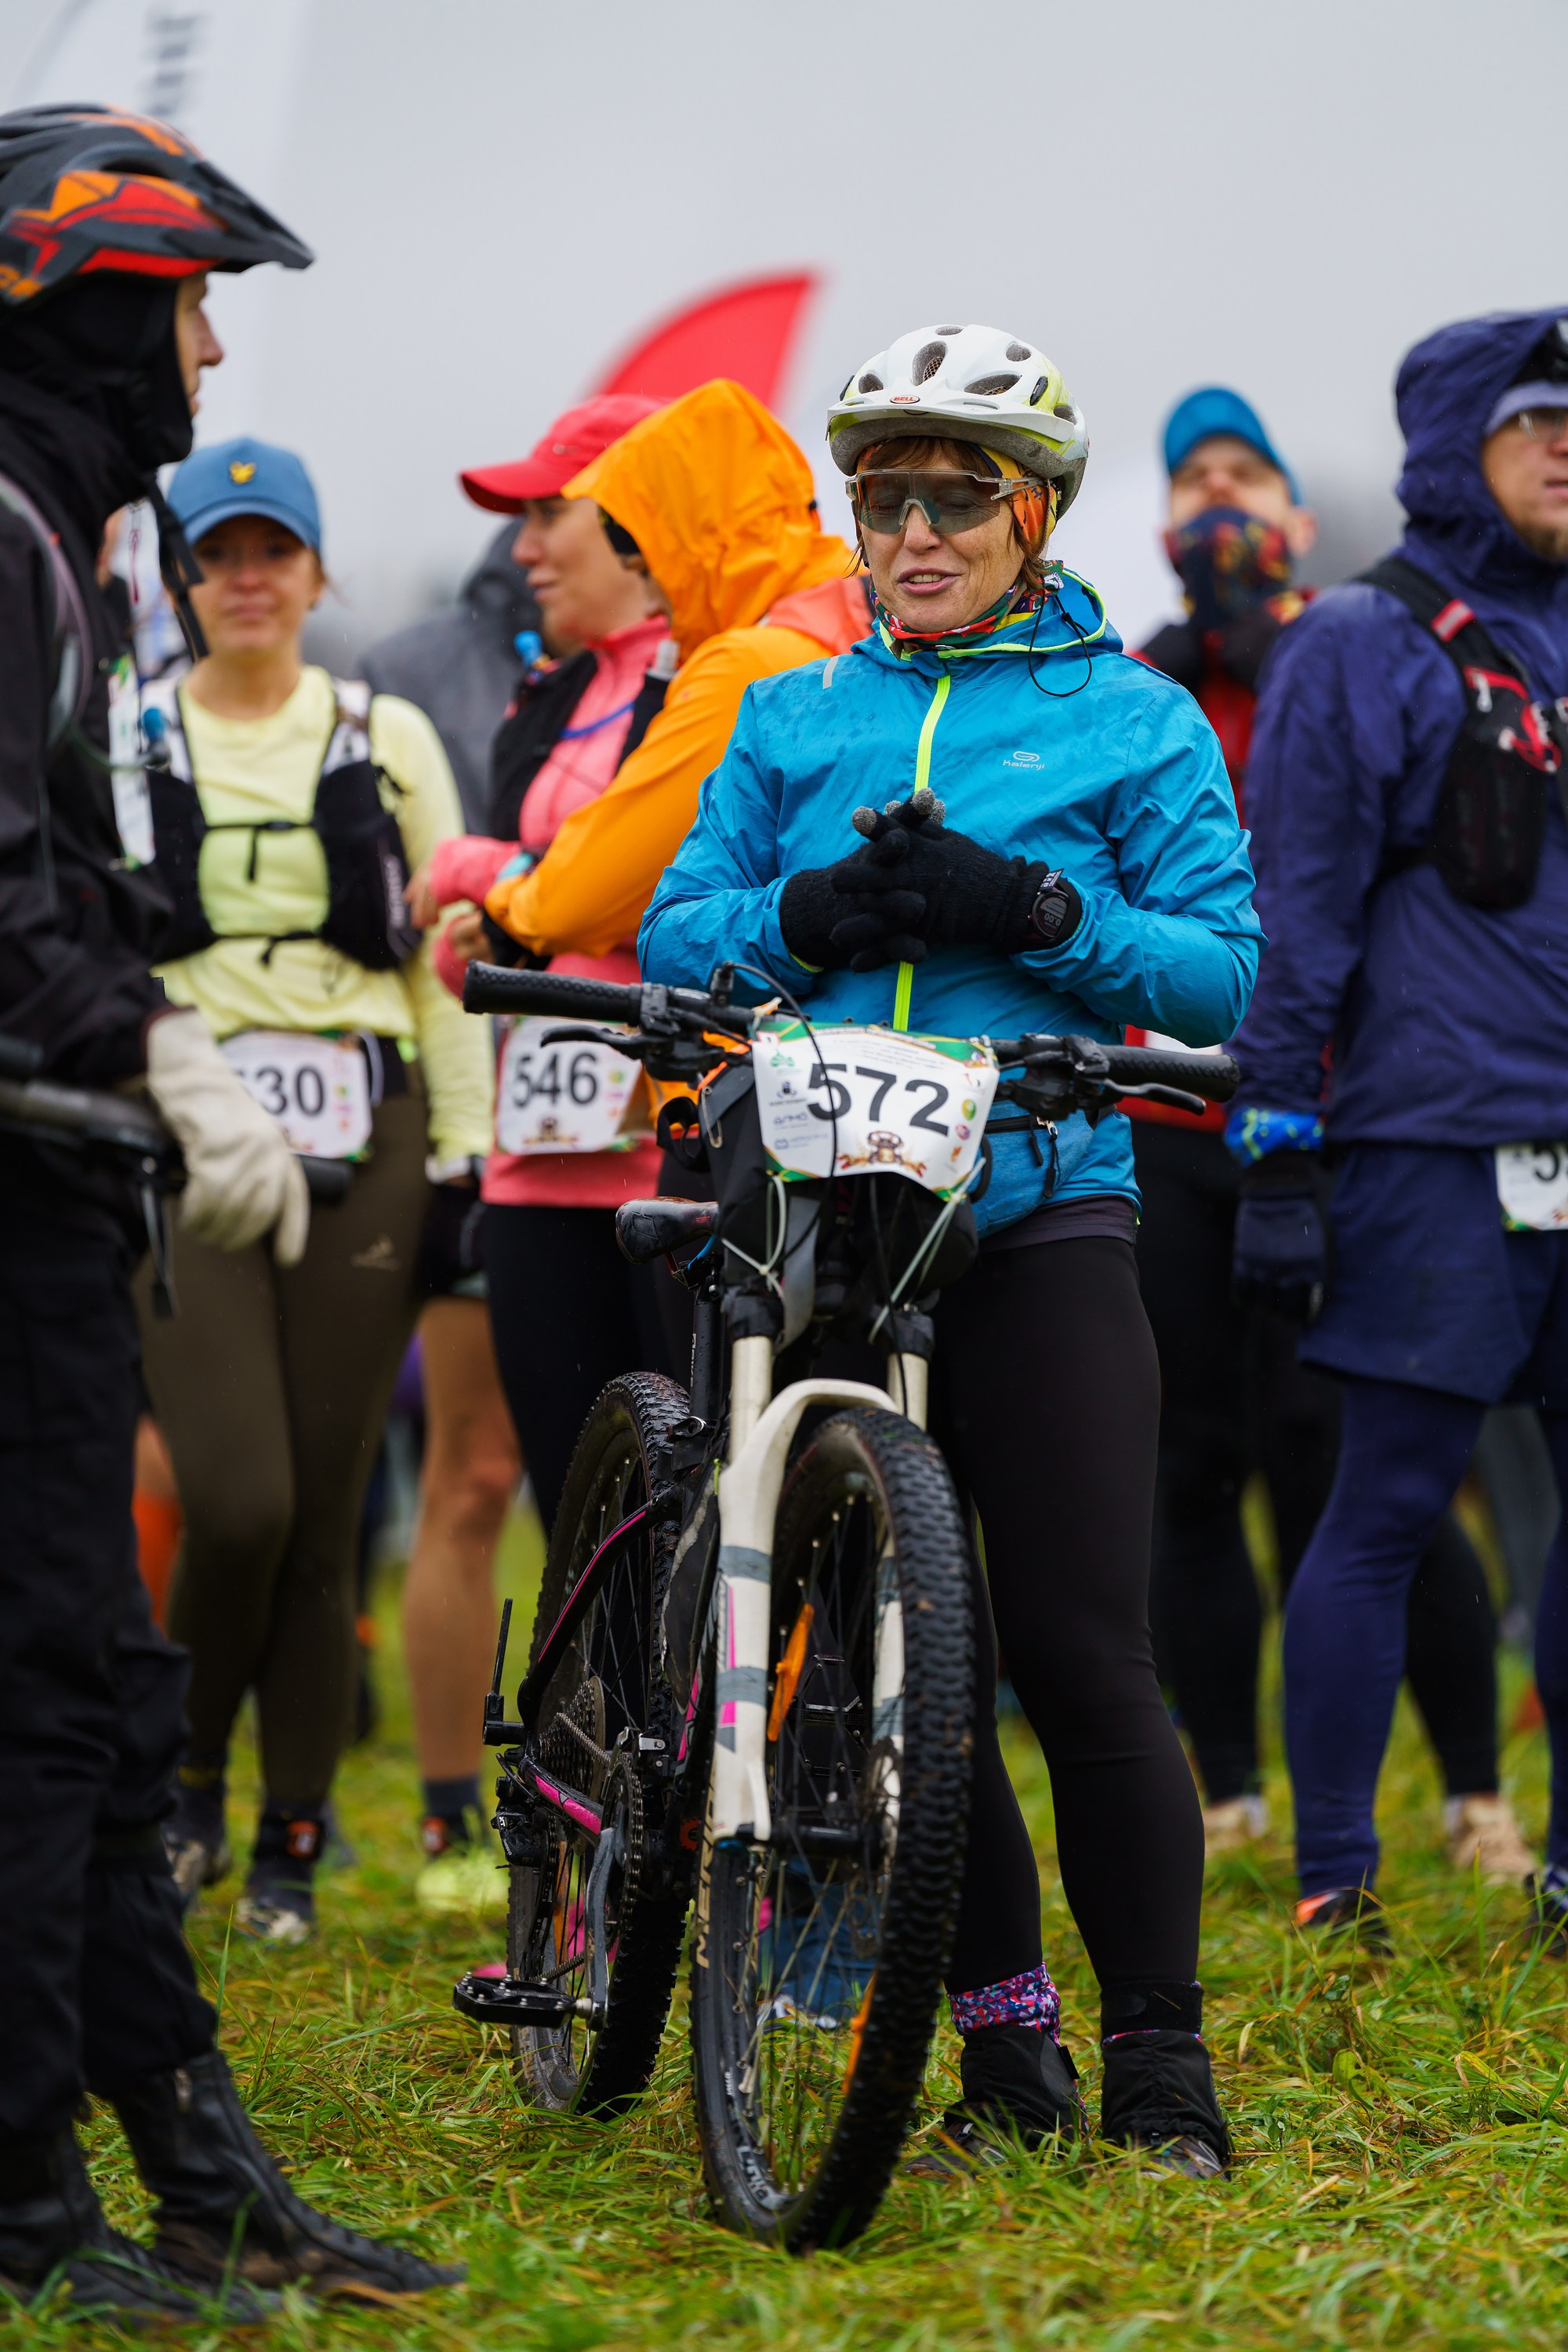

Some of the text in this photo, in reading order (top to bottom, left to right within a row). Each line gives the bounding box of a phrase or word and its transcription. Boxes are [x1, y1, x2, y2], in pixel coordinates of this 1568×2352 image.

[1003, 760, 1045, 770] Kalenji
[236, 1065, 325, 1117] 30
[514, 1051, 597, 1109] 546
[808, 1063, 949, 1137] 572
